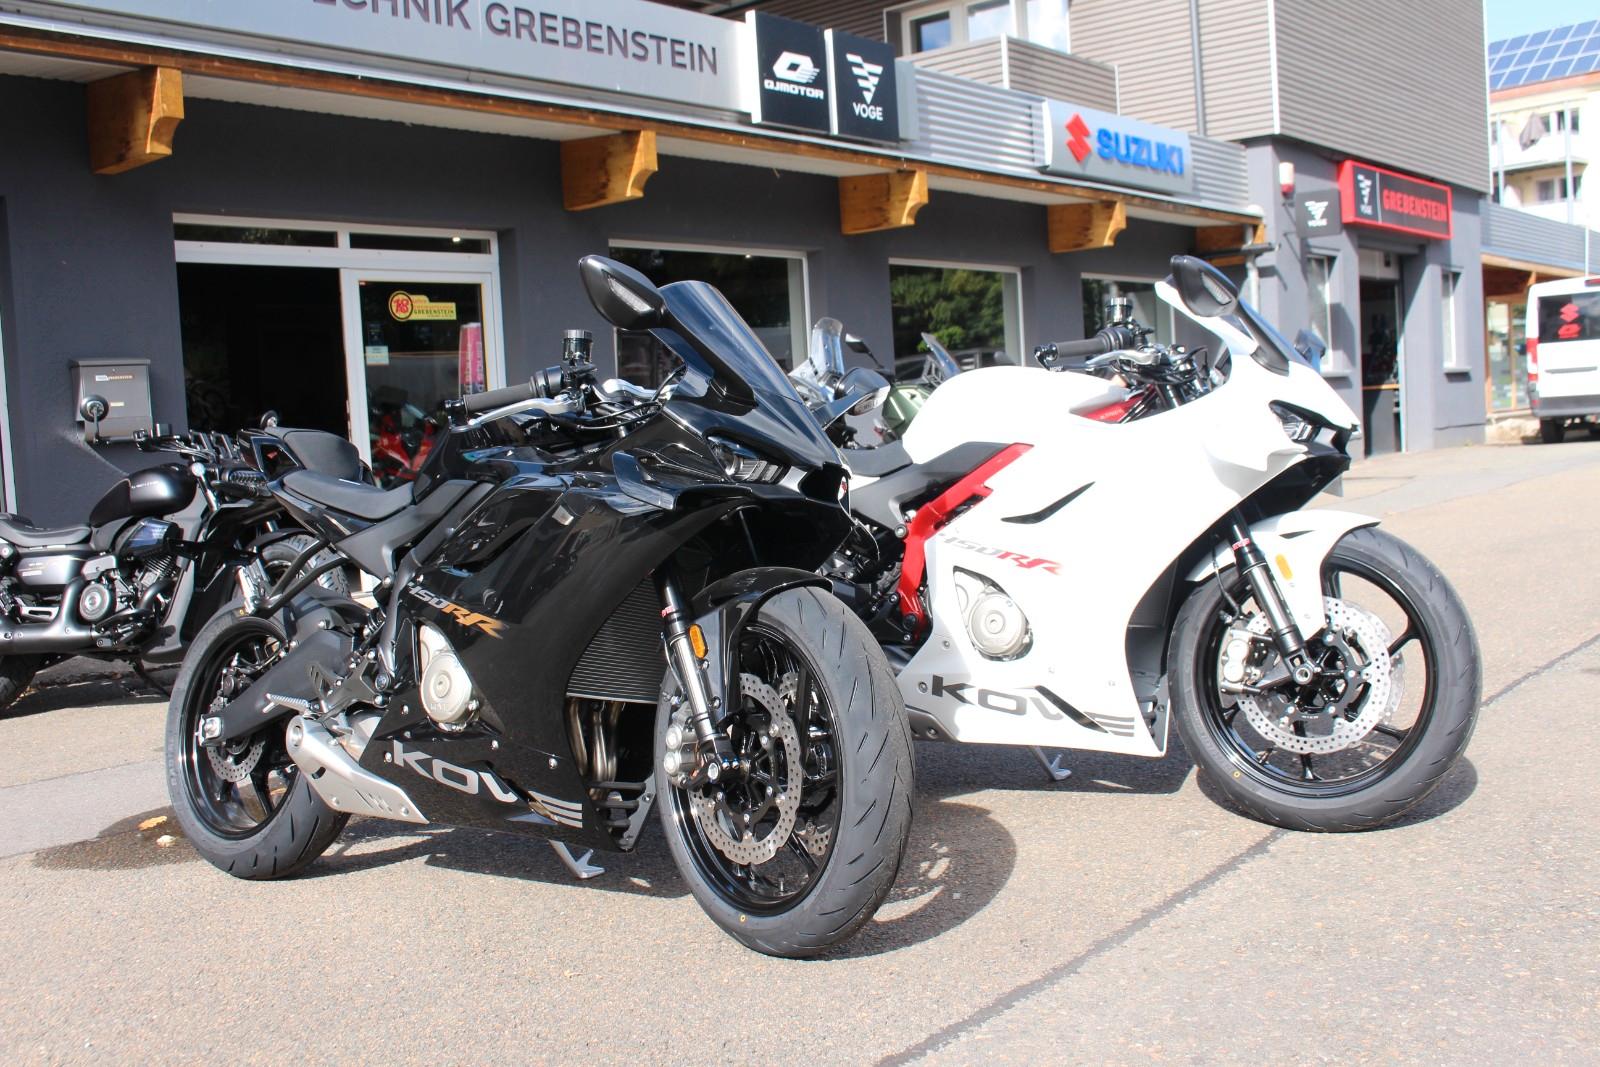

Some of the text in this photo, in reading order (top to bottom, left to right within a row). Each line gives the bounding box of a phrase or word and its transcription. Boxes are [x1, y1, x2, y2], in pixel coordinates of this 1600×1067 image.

[313, 0, 718, 75] NIK GREBENSTEIN
[852, 102, 884, 121] VOGE
[1096, 128, 1184, 176] SUZUKI
[1383, 188, 1448, 221] GREBENSTEIN
